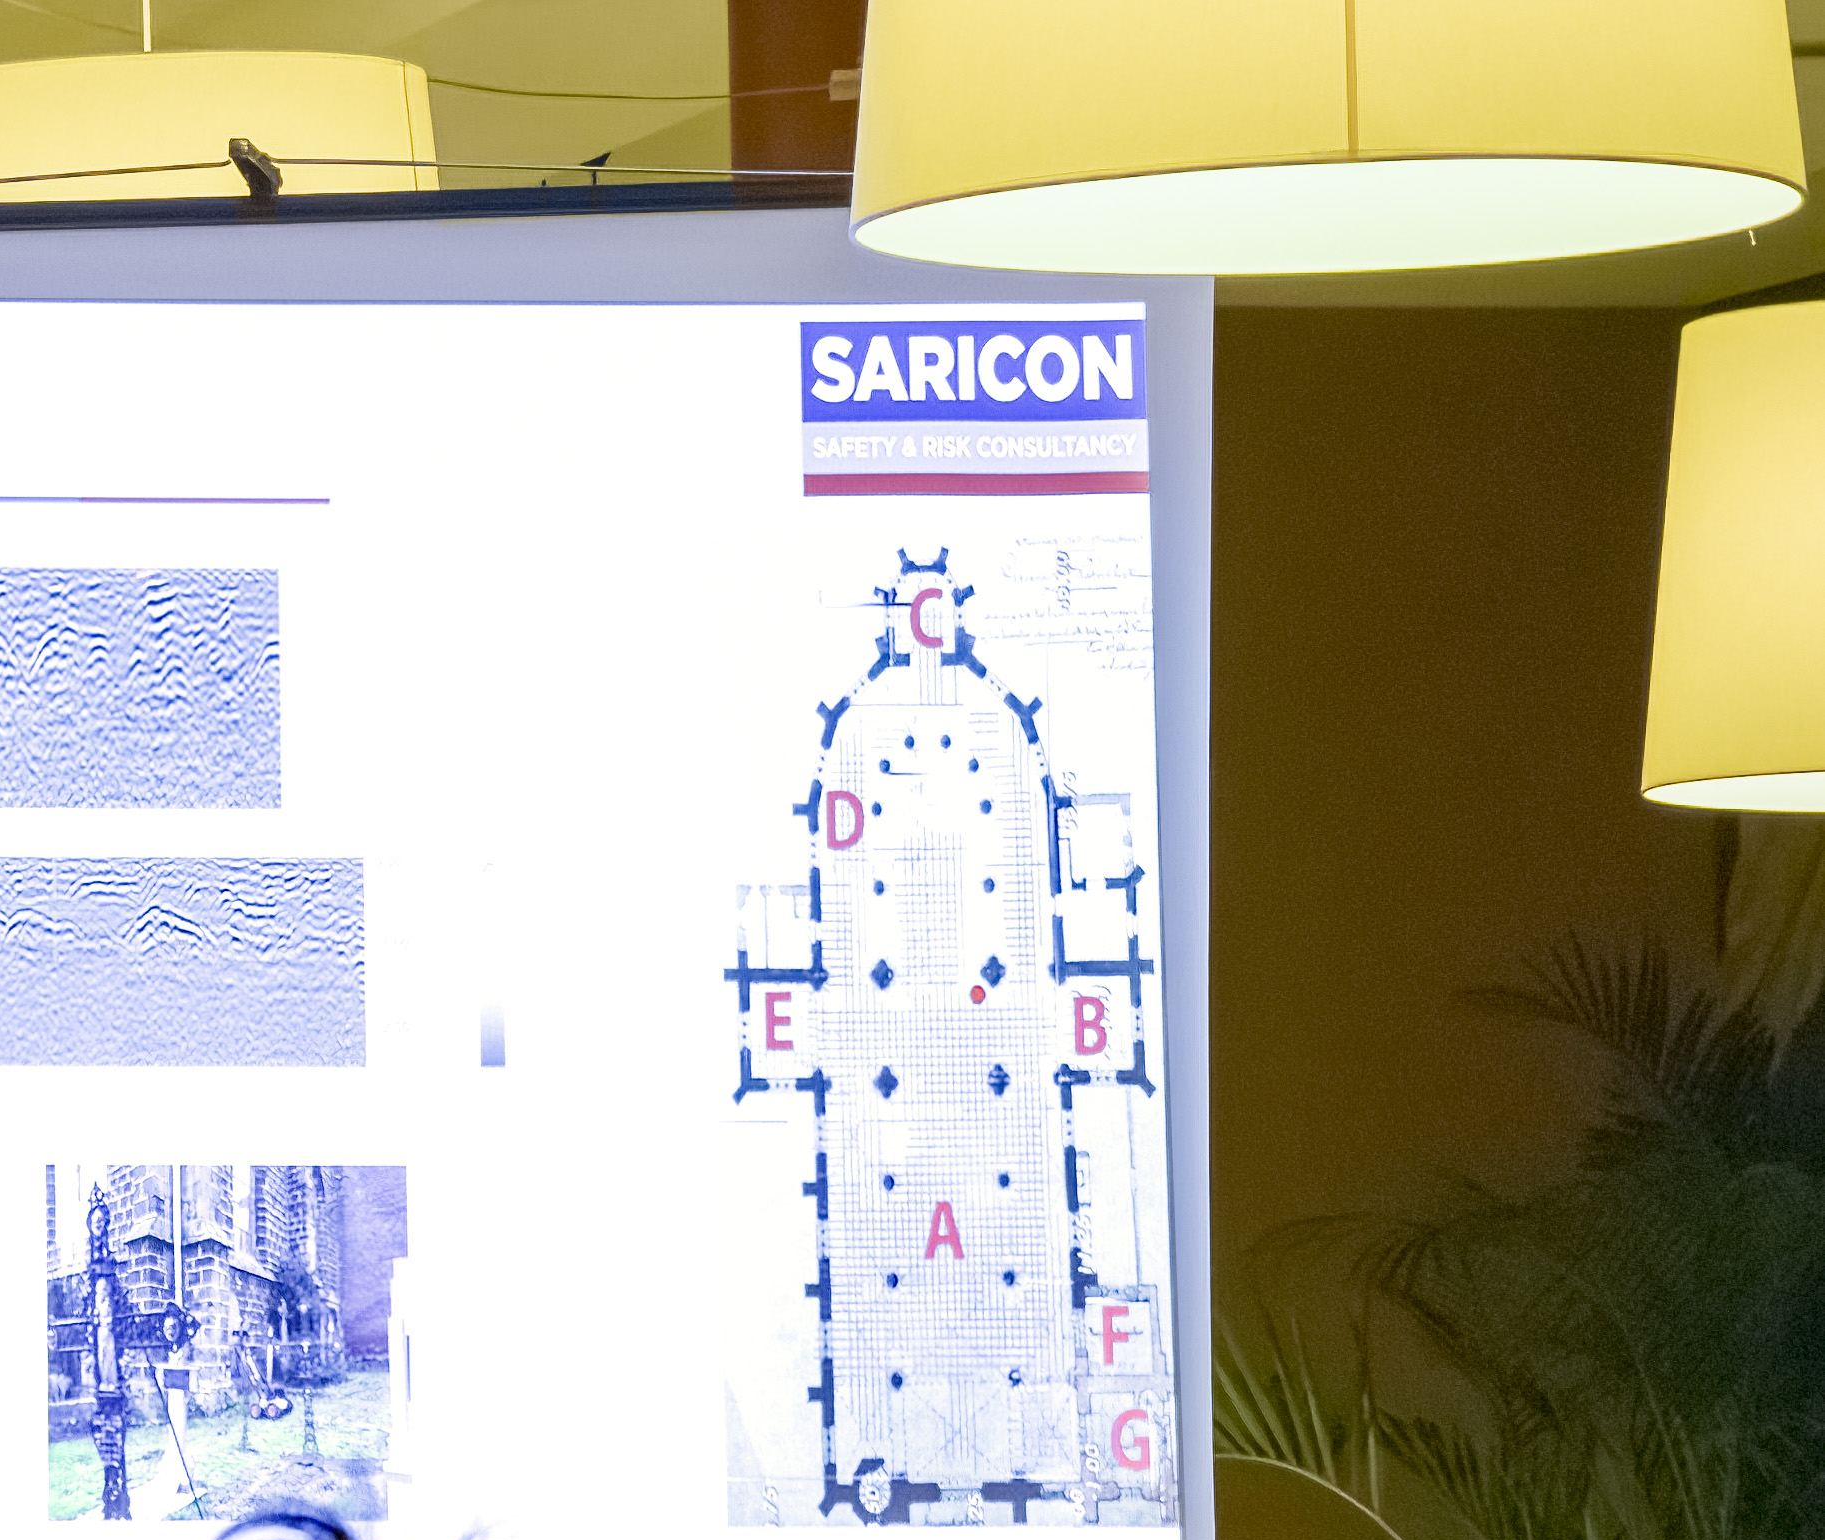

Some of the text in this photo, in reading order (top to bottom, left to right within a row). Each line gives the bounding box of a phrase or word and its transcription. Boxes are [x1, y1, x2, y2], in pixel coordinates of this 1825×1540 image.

[810, 335, 1134, 403] SARICON
[813, 432, 1138, 459] SAFETY & RISK CONSULTANCY
[910, 589, 943, 648] C
[826, 790, 864, 851] D
[765, 991, 794, 1051] E
[1074, 996, 1108, 1055] B
[925, 1201, 965, 1259] A
[1101, 1305, 1130, 1366] F
[1110, 1408, 1151, 1472] G
